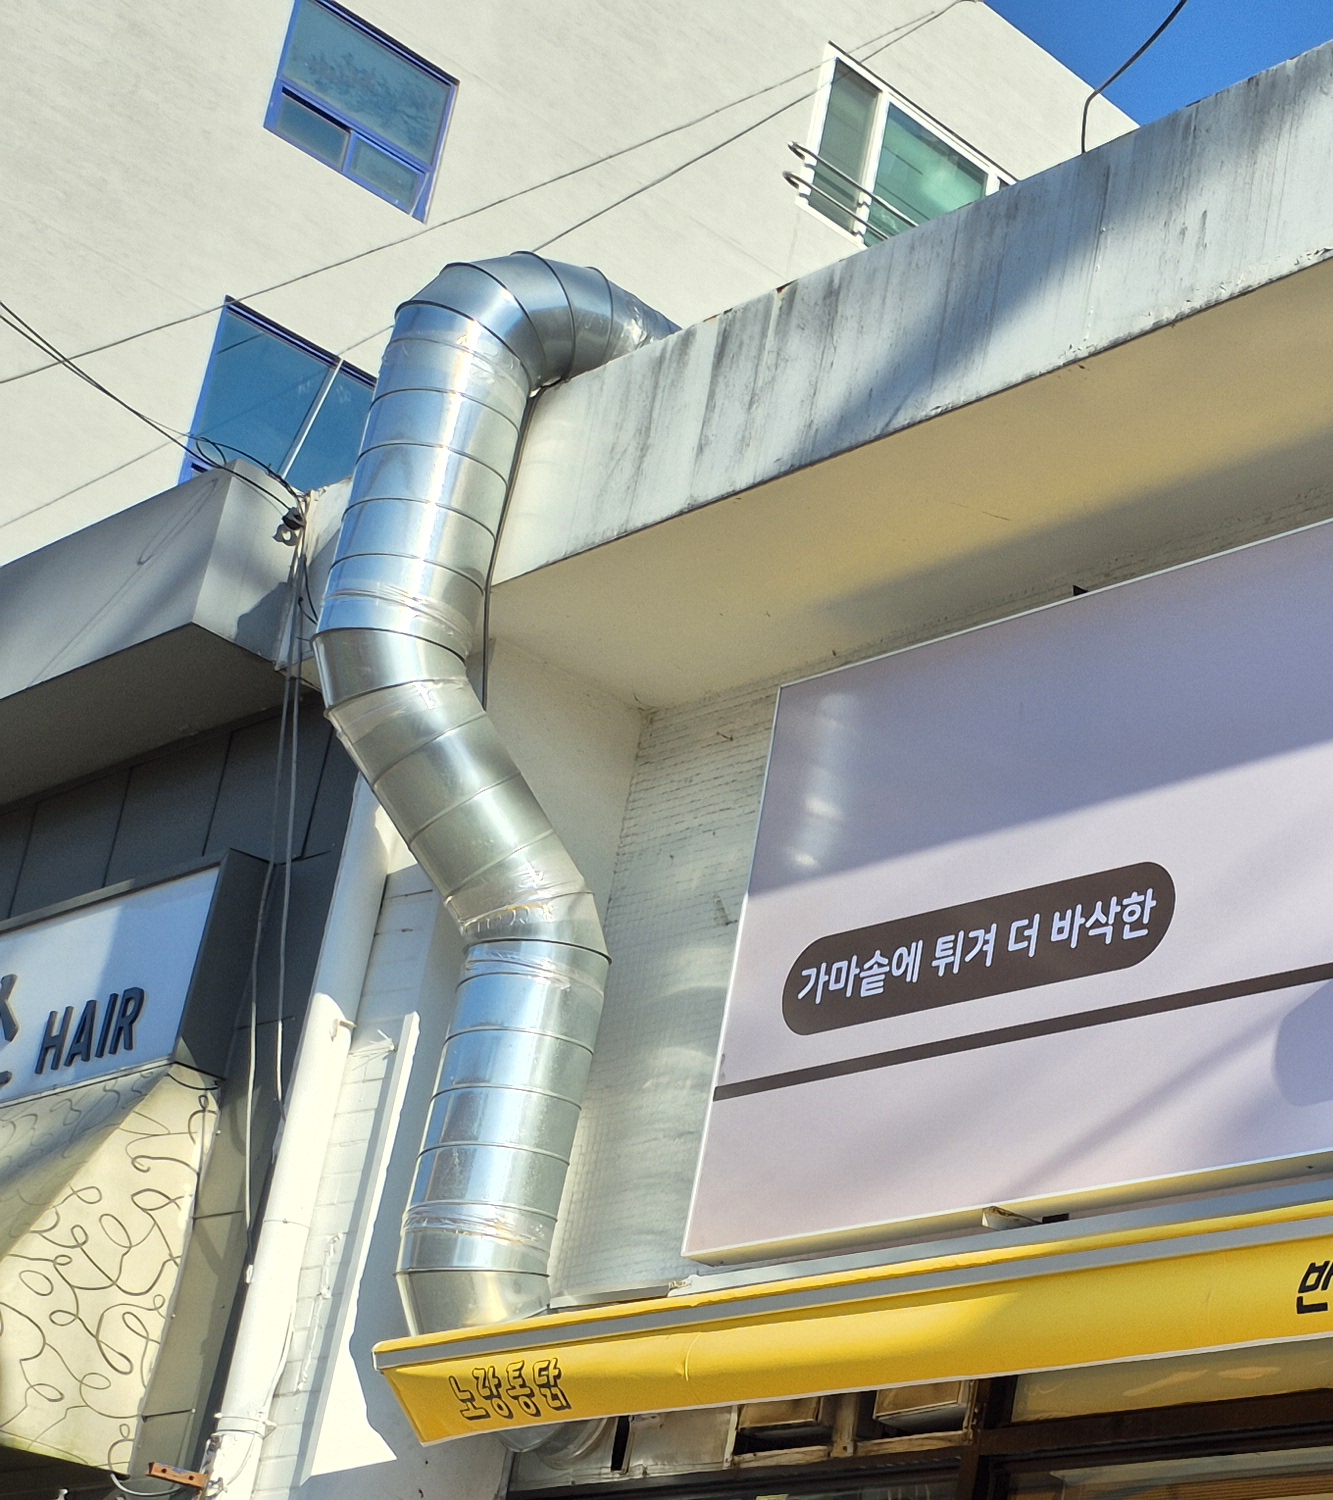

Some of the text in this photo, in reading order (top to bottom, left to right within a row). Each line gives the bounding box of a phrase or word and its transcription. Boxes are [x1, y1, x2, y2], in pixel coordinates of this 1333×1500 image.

[798, 888, 1157, 1004] 가마솥에 튀겨 더 바삭한
[34, 987, 145, 1075] HAIR
[448, 1357, 572, 1421] 노랑통닭
